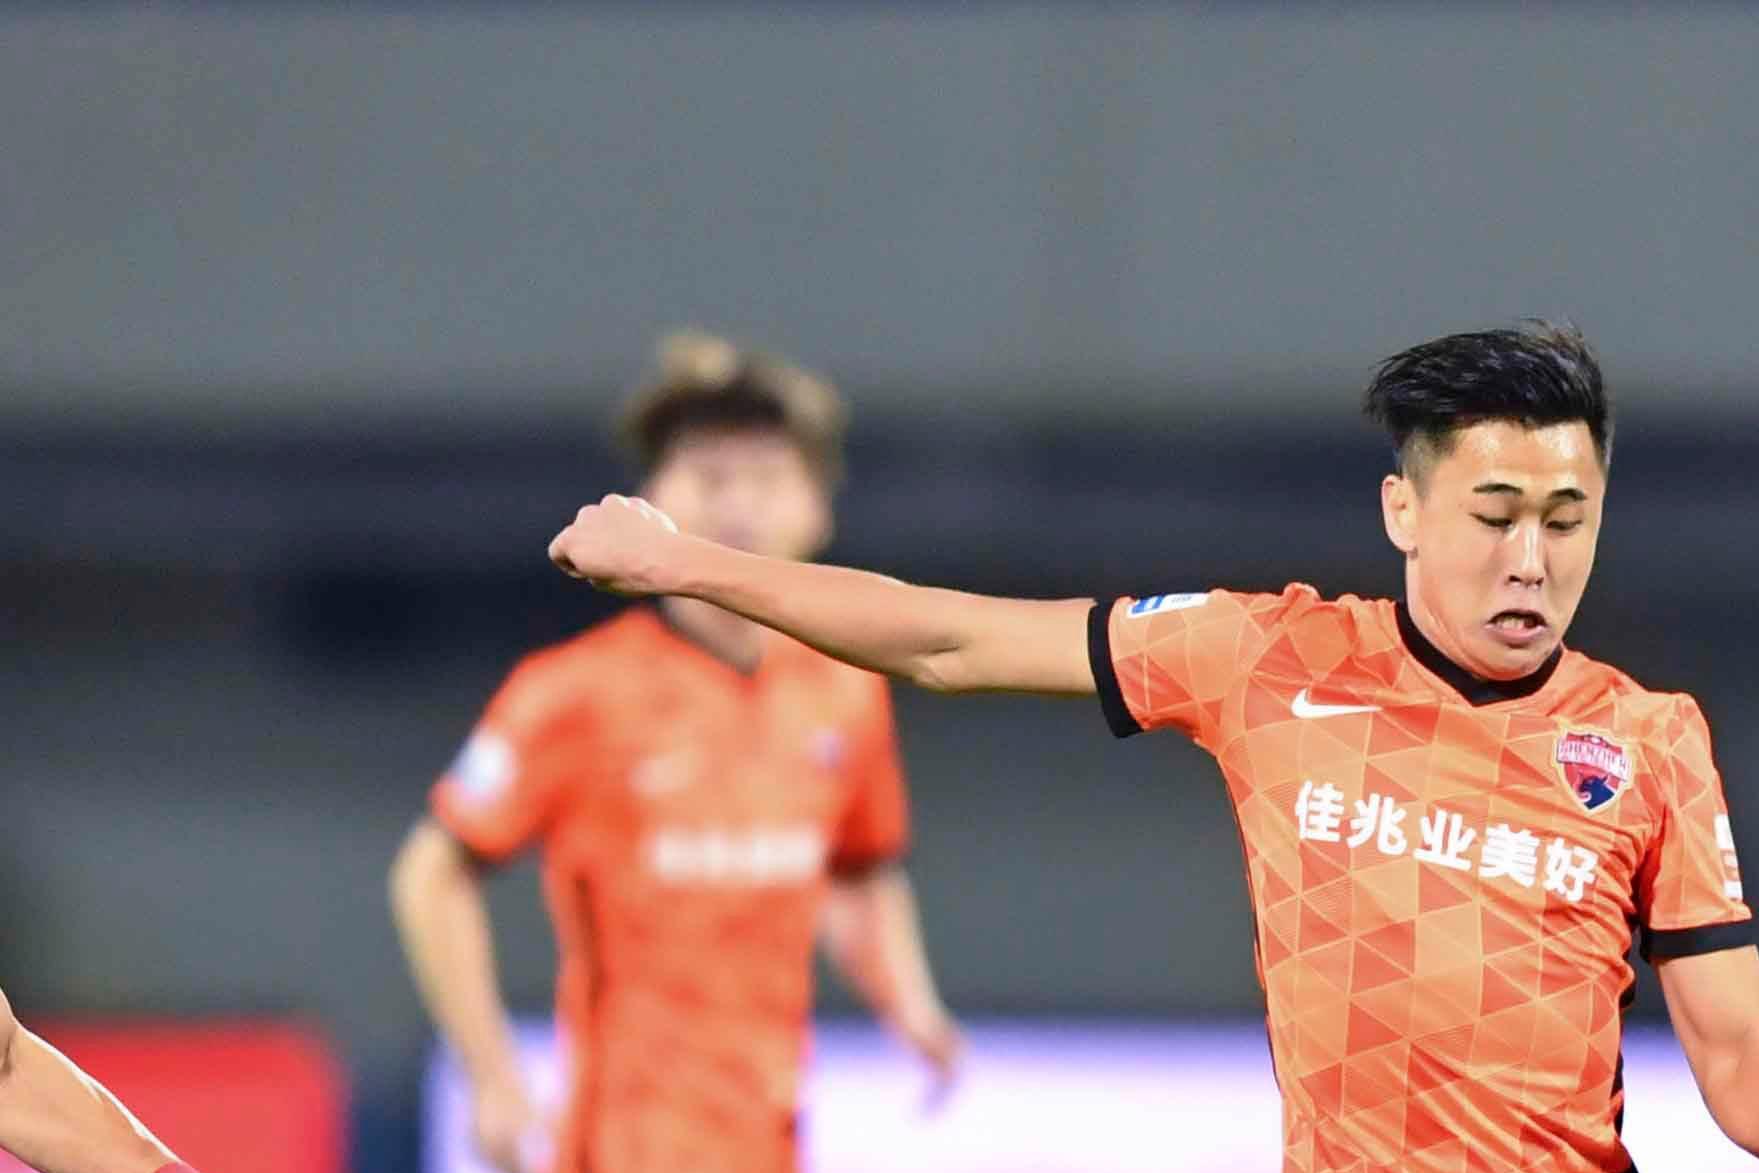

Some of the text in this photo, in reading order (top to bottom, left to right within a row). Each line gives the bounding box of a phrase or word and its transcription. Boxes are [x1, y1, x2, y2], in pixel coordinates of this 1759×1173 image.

[1294, 780, 1600, 902] 佳兆业美好
